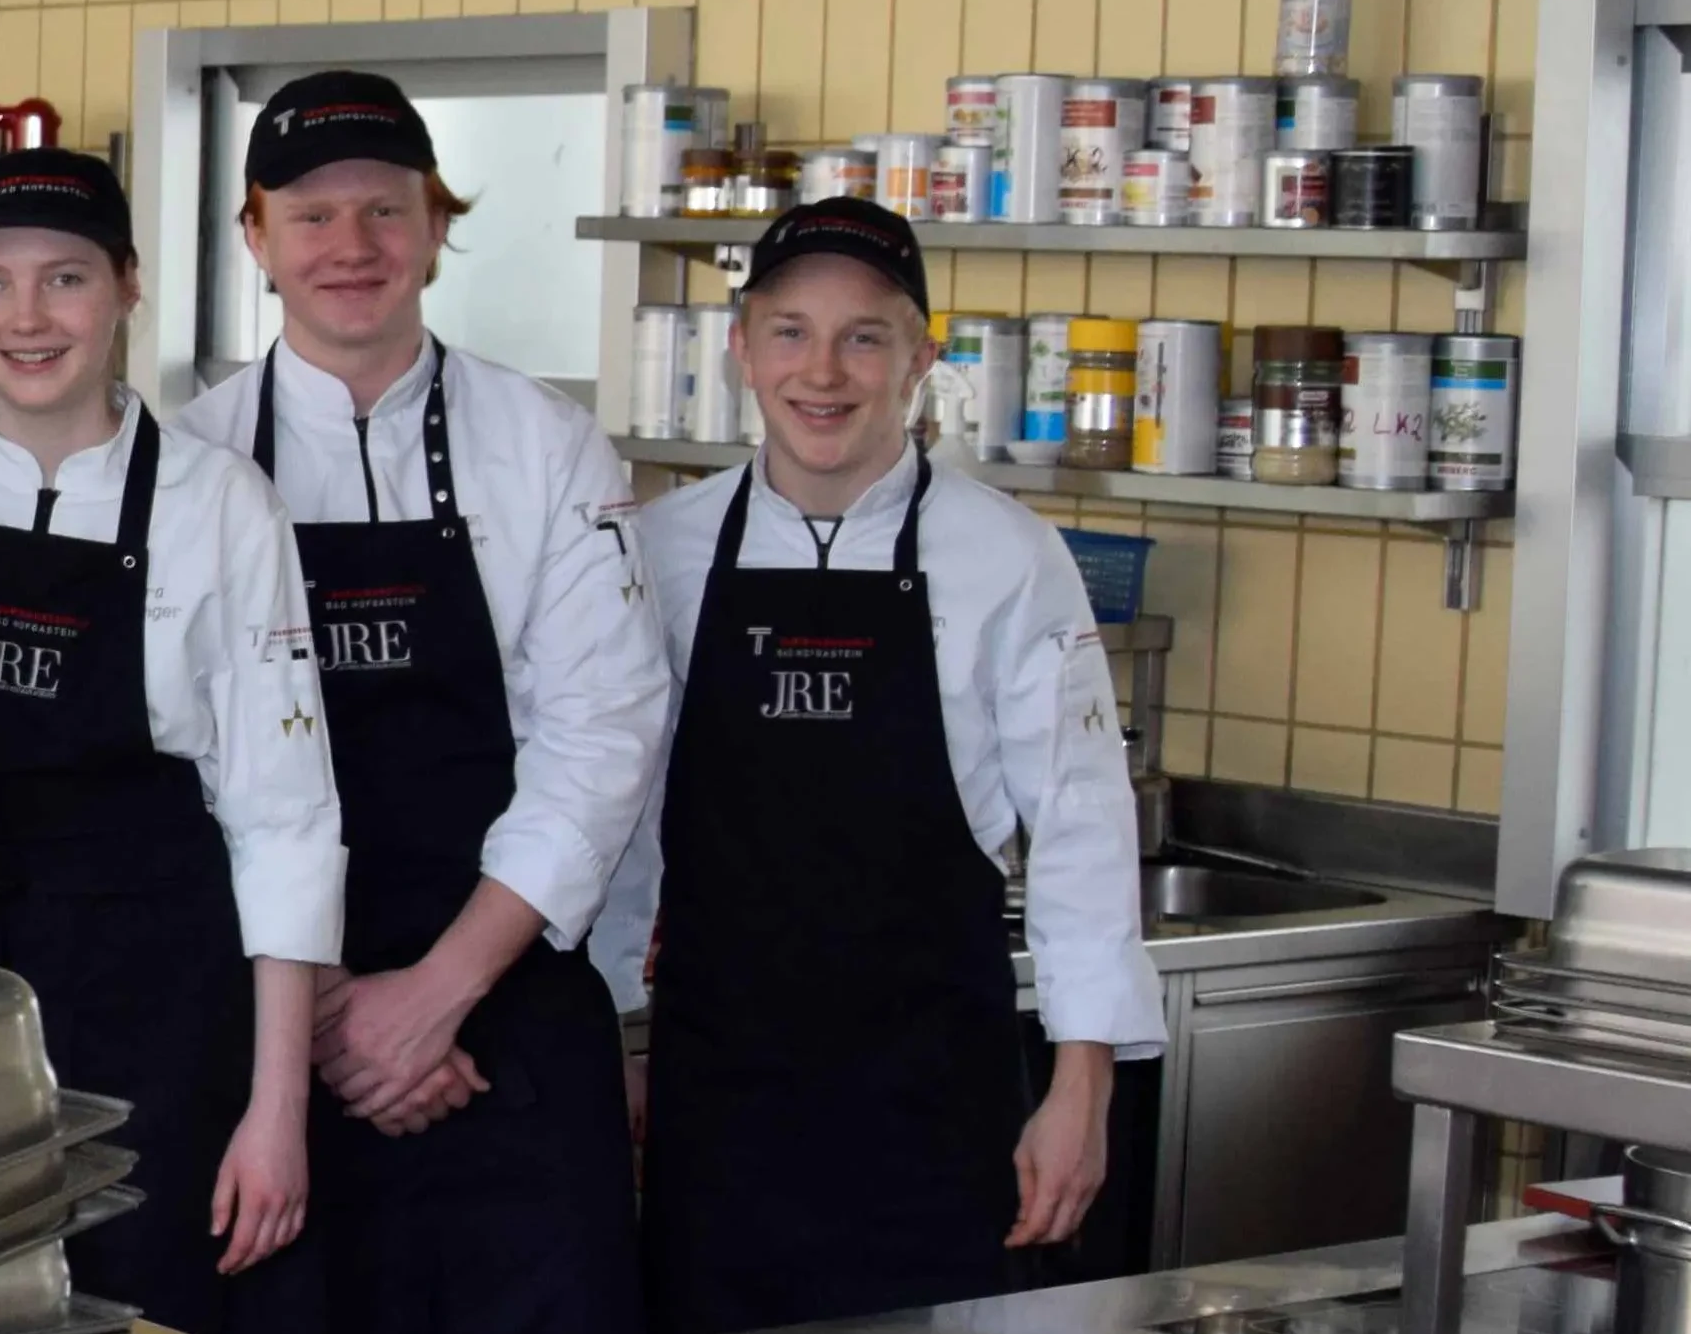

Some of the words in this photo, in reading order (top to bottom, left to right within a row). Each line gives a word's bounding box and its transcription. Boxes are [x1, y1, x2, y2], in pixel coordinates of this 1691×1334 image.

[319, 620, 411, 671] JRE
[746, 626, 773, 657] T
[760, 671, 853, 719] JRE
